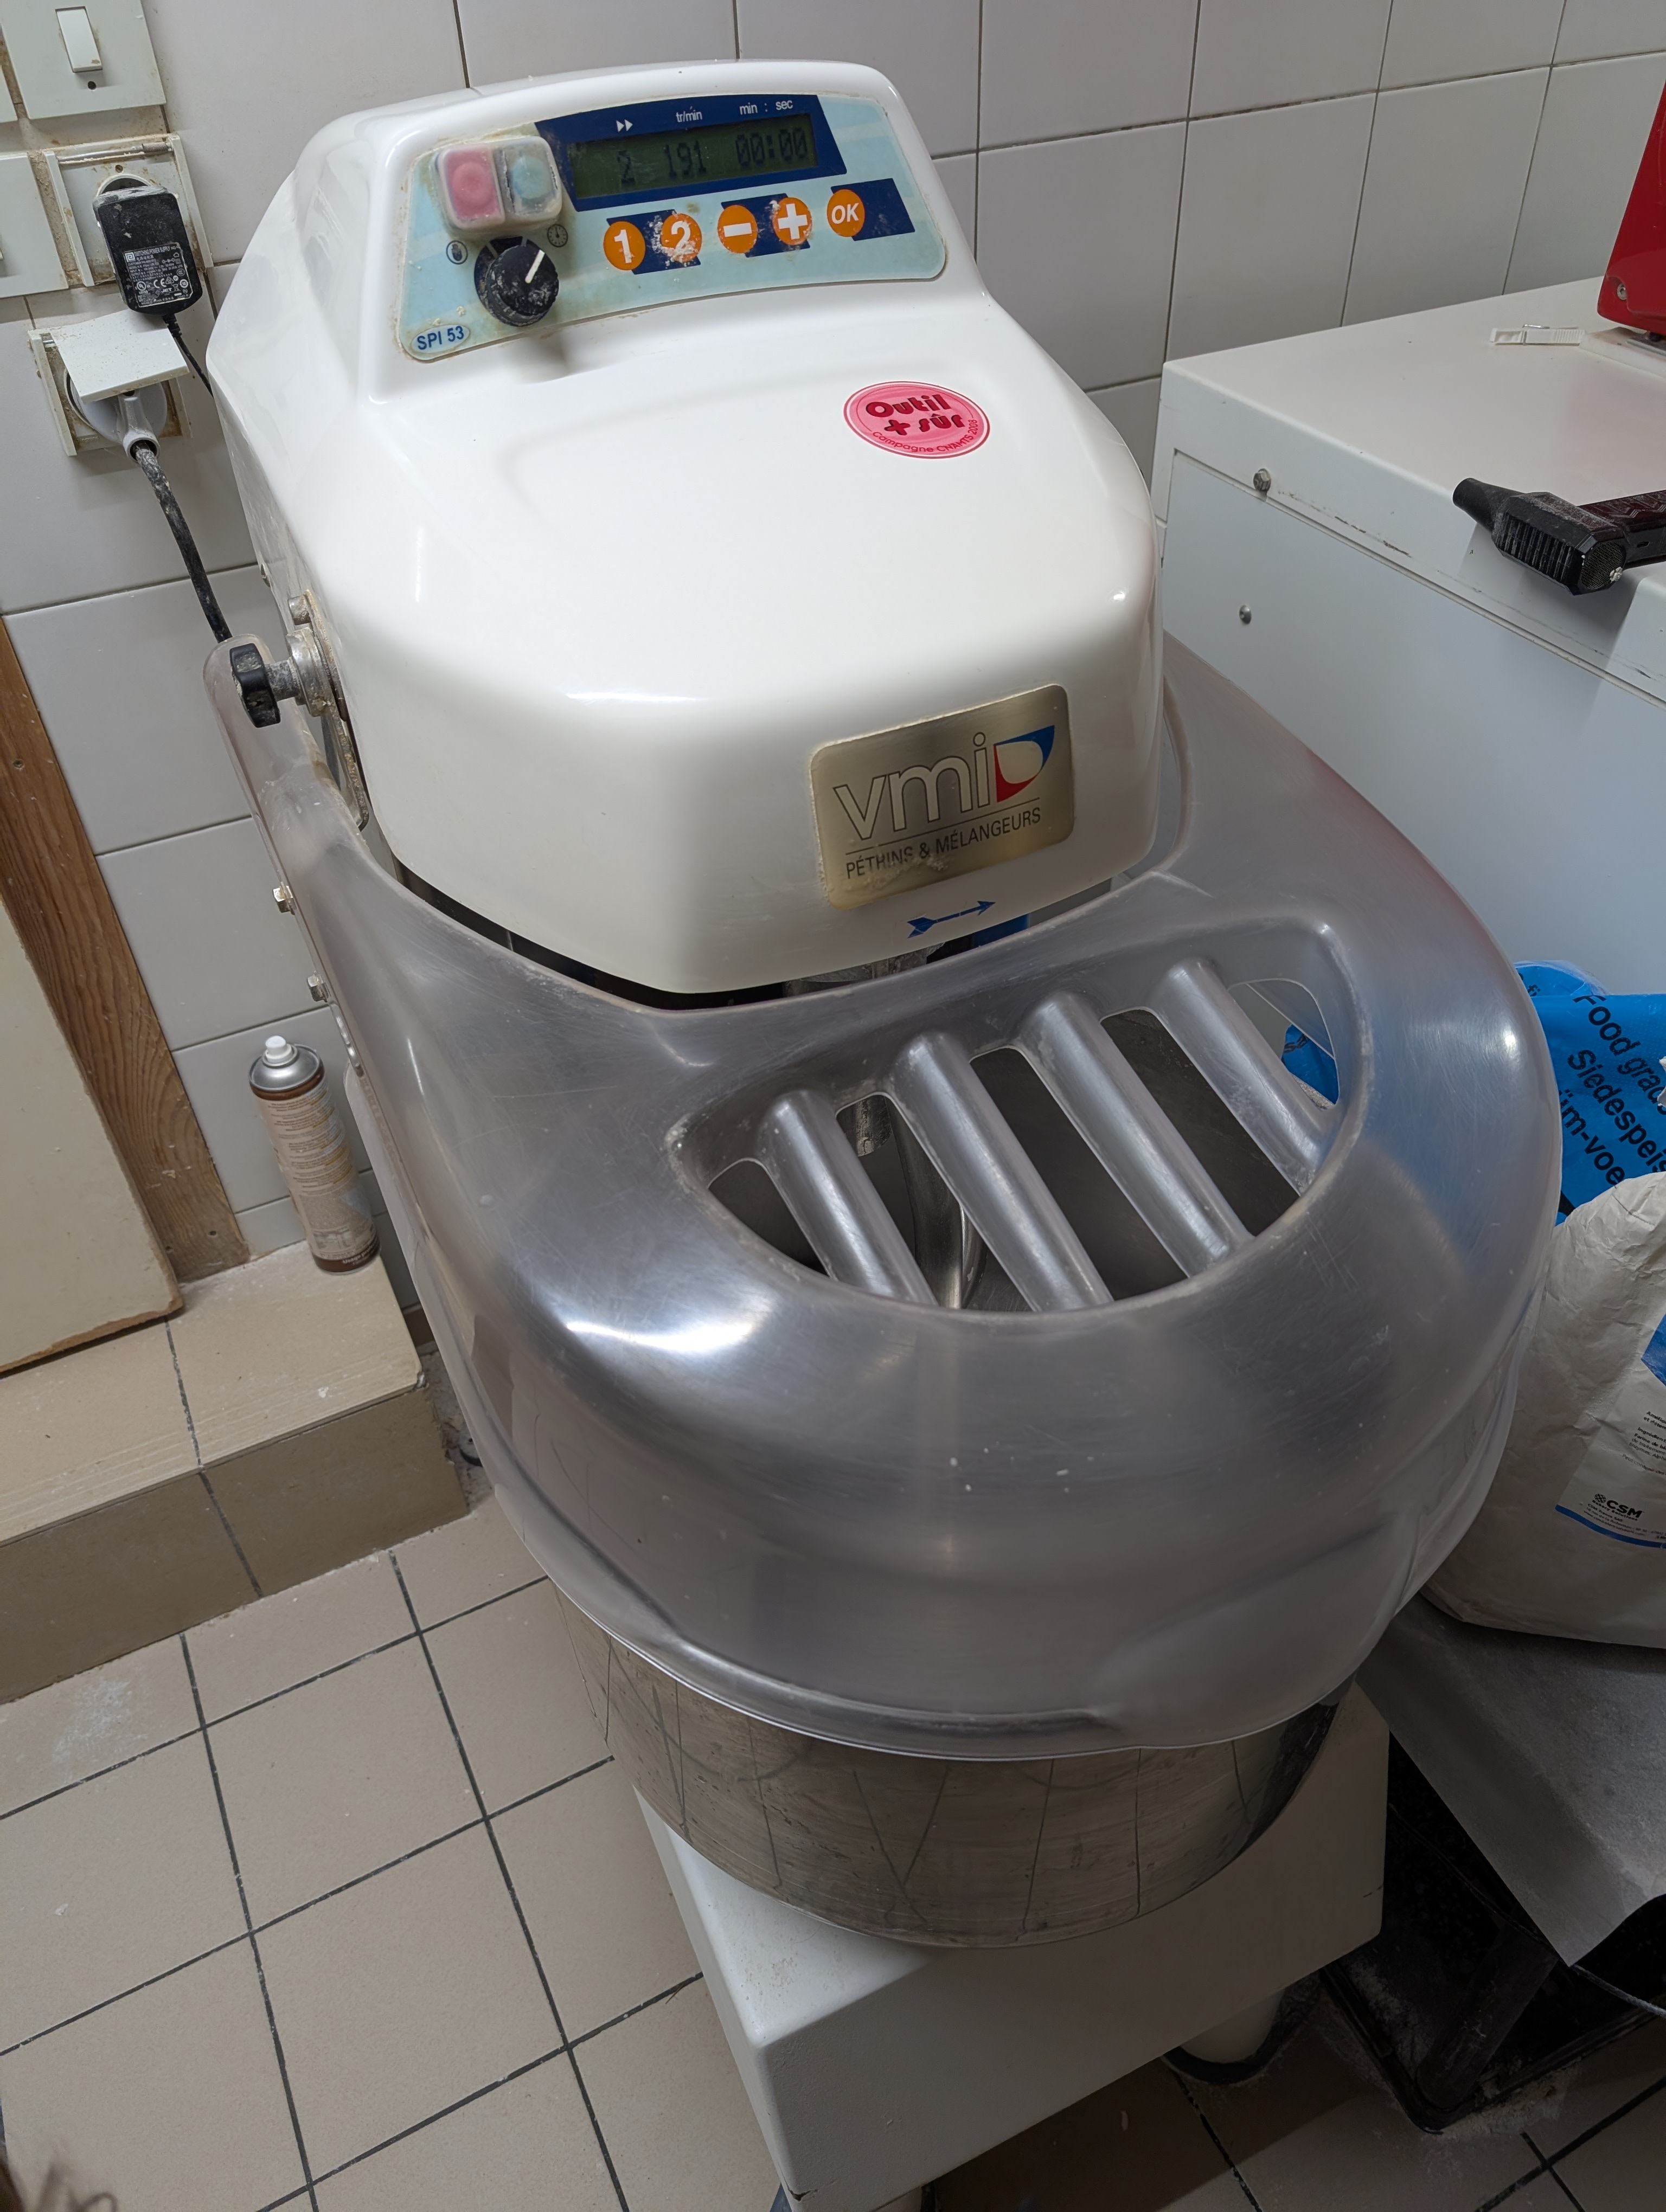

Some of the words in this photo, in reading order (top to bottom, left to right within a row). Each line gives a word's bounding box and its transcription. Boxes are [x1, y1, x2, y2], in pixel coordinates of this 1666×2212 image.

[676, 110, 702, 123] tr/min
[739, 102, 758, 115] min
[776, 99, 793, 110] sec
[663, 139, 706, 179] 191
[735, 127, 808, 168] 00:00
[831, 202, 860, 224] OK
[614, 229, 632, 264] 1
[671, 221, 695, 255] 2
[417, 331, 442, 350] SPI
[447, 325, 464, 342] 53
[866, 394, 951, 417] Outil
[919, 413, 965, 432] sûr
[873, 432, 934, 452] Campagne
[936, 434, 974, 452] CNAMTS
[967, 419, 978, 435] 2008
[833, 732, 990, 841] vmi
[919, 842, 930, 859] &
[935, 807, 1041, 855] MÉLANGEURS
[1573, 994, 1642, 1057] Food
[1592, 1500, 1610, 1511] Bakery
[1612, 1509, 1638, 1521] Solutions
[1606, 1500, 1643, 1518] CSM
